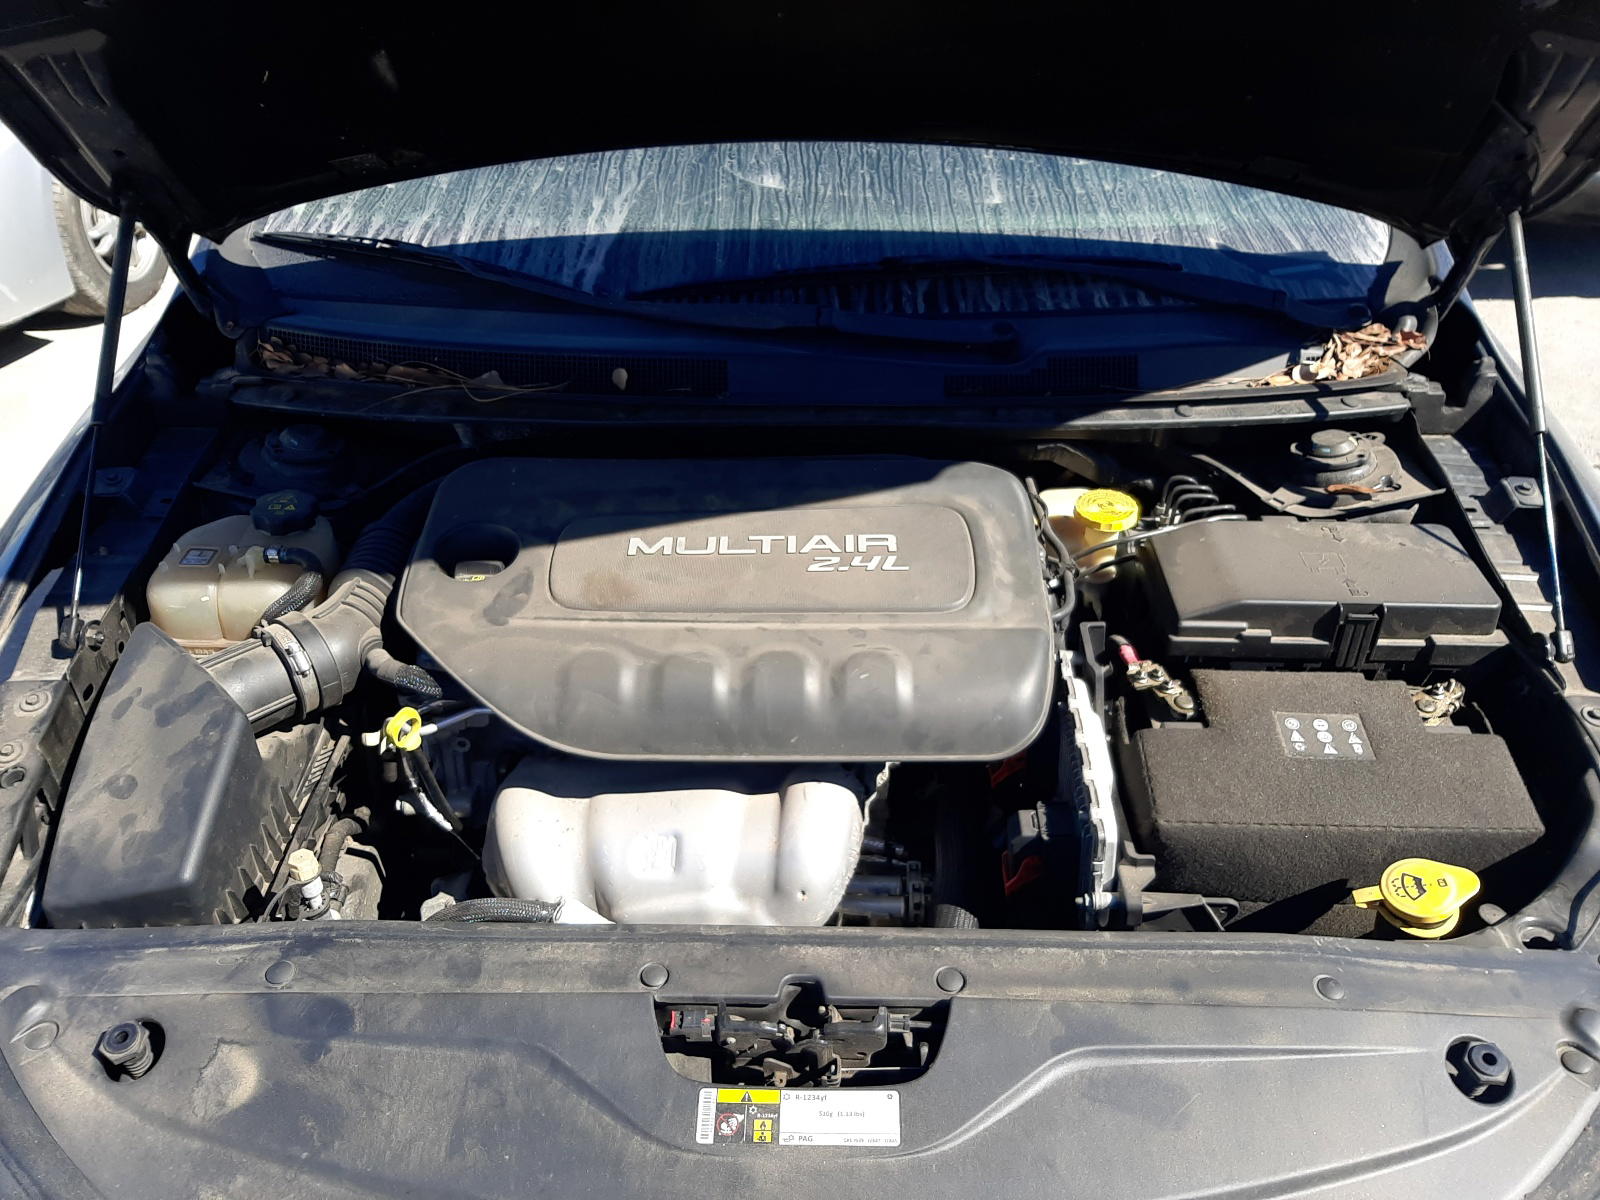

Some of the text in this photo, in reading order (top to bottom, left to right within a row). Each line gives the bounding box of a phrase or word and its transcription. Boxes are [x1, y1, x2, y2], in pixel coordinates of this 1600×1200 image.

[627, 534, 898, 556] MULTIAIR
[807, 555, 910, 572] 2.4L
[798, 1135, 813, 1143] PAG
